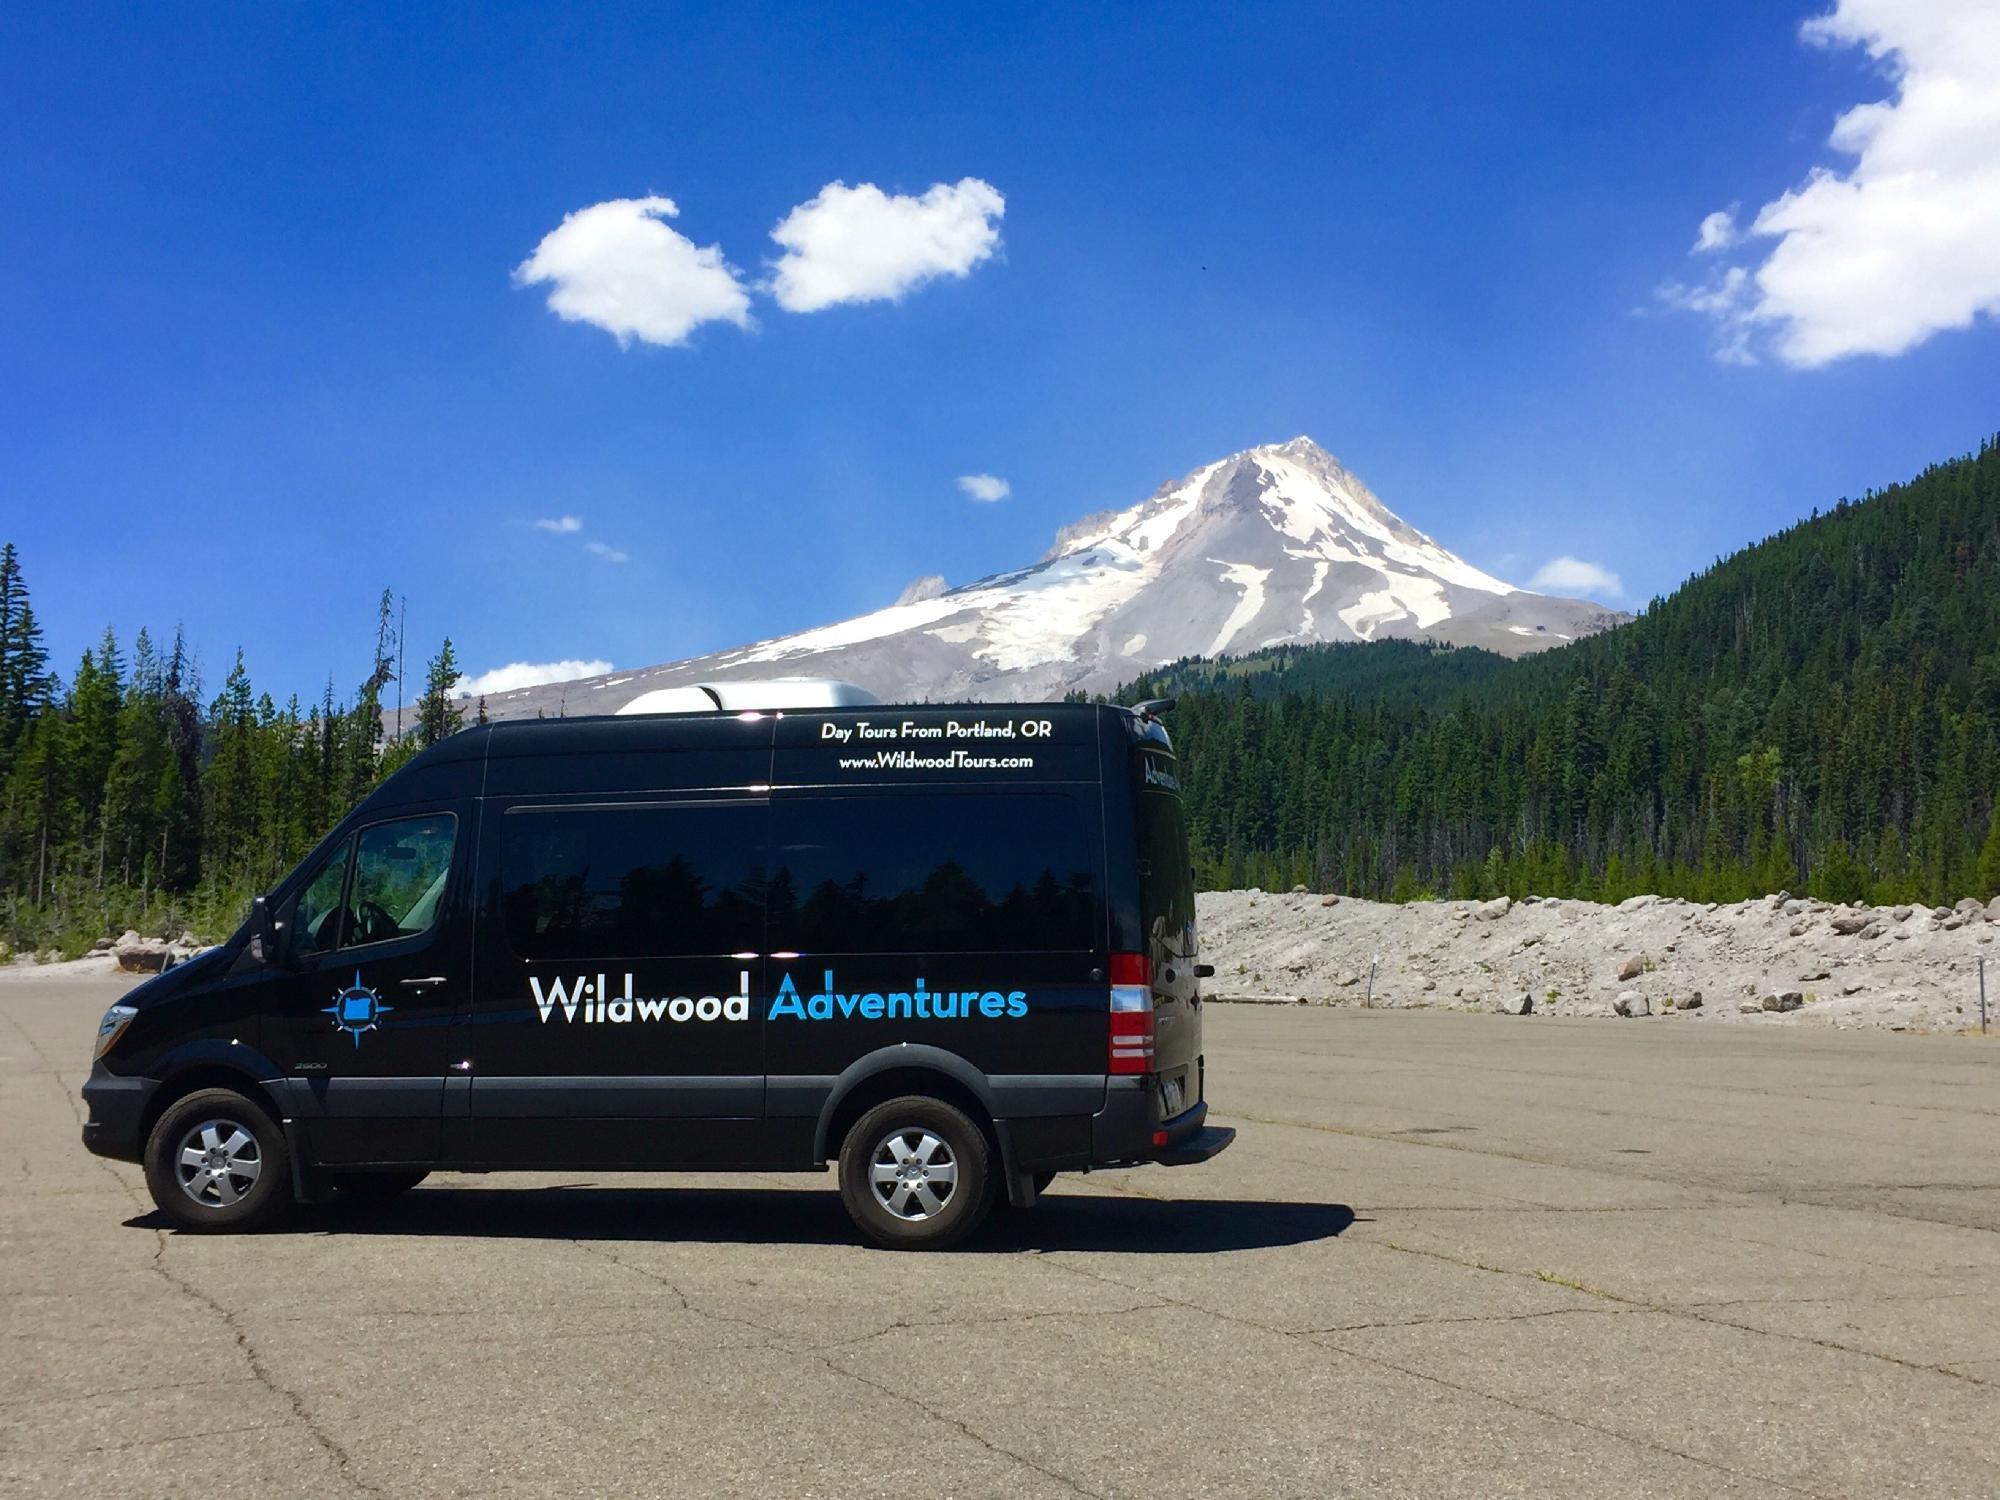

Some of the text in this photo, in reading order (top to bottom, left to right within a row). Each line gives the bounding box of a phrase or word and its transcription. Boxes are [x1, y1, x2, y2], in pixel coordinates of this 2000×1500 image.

[821, 720, 1053, 743] Day Tours From Portland, OR
[838, 750, 1034, 769] www.WildwoodTours.com
[529, 969, 1029, 1024] Wildwood Adventures
